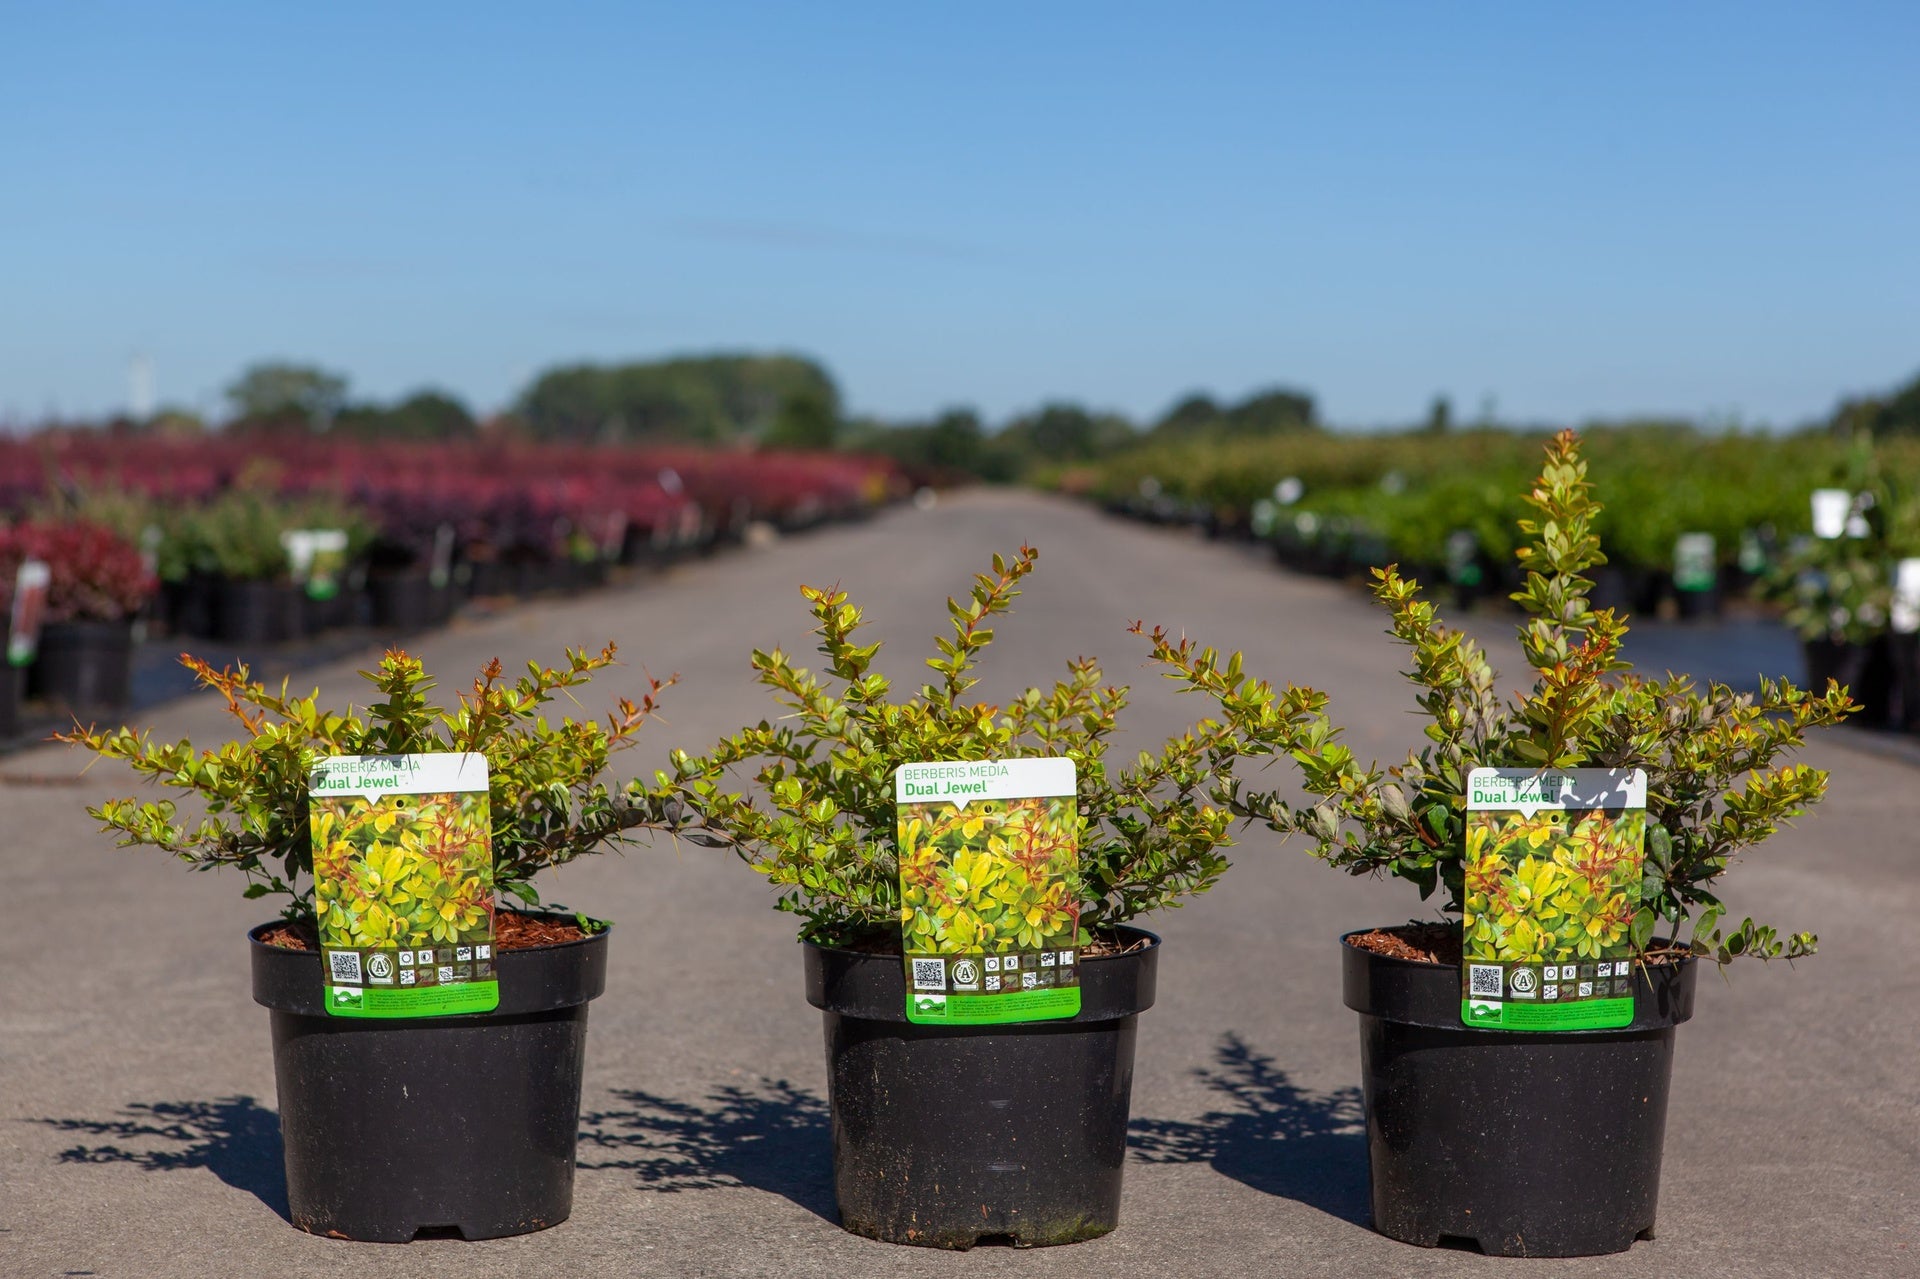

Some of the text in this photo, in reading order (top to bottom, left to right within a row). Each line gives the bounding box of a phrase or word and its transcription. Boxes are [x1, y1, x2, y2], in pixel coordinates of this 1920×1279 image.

[380, 759, 421, 772] MEDIA
[904, 765, 1009, 780] BERBERIS MEDIA
[317, 775, 399, 789] Dual Jewel
[905, 780, 987, 796] Dual Jewel
[1473, 775, 1577, 787] BERBERIS MEDIA
[1473, 789, 1555, 803] Dual Jewel
